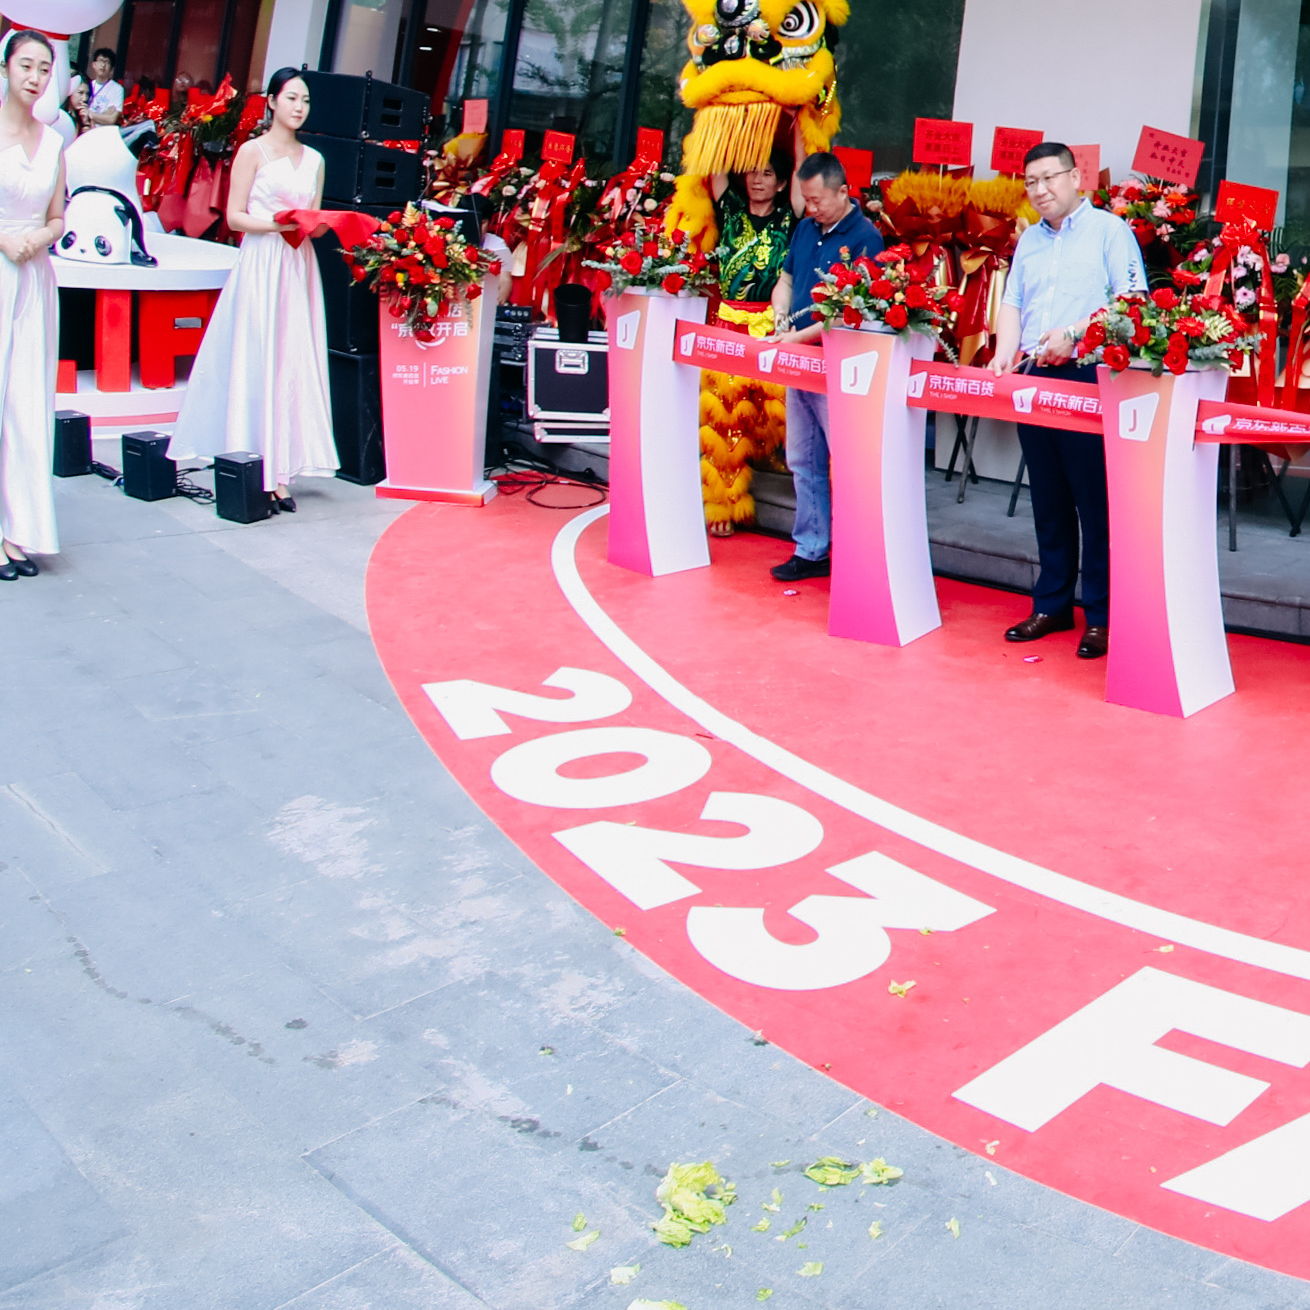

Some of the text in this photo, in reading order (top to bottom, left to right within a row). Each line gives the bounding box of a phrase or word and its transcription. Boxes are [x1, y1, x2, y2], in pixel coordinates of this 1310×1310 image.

[696, 336, 746, 358] 京东新百货
[431, 365, 468, 376] FASHION
[431, 376, 449, 385] LIVE
[929, 375, 994, 397] 京东新百货
[1037, 391, 1103, 414] 京东新百
[422, 667, 997, 992] 2023
